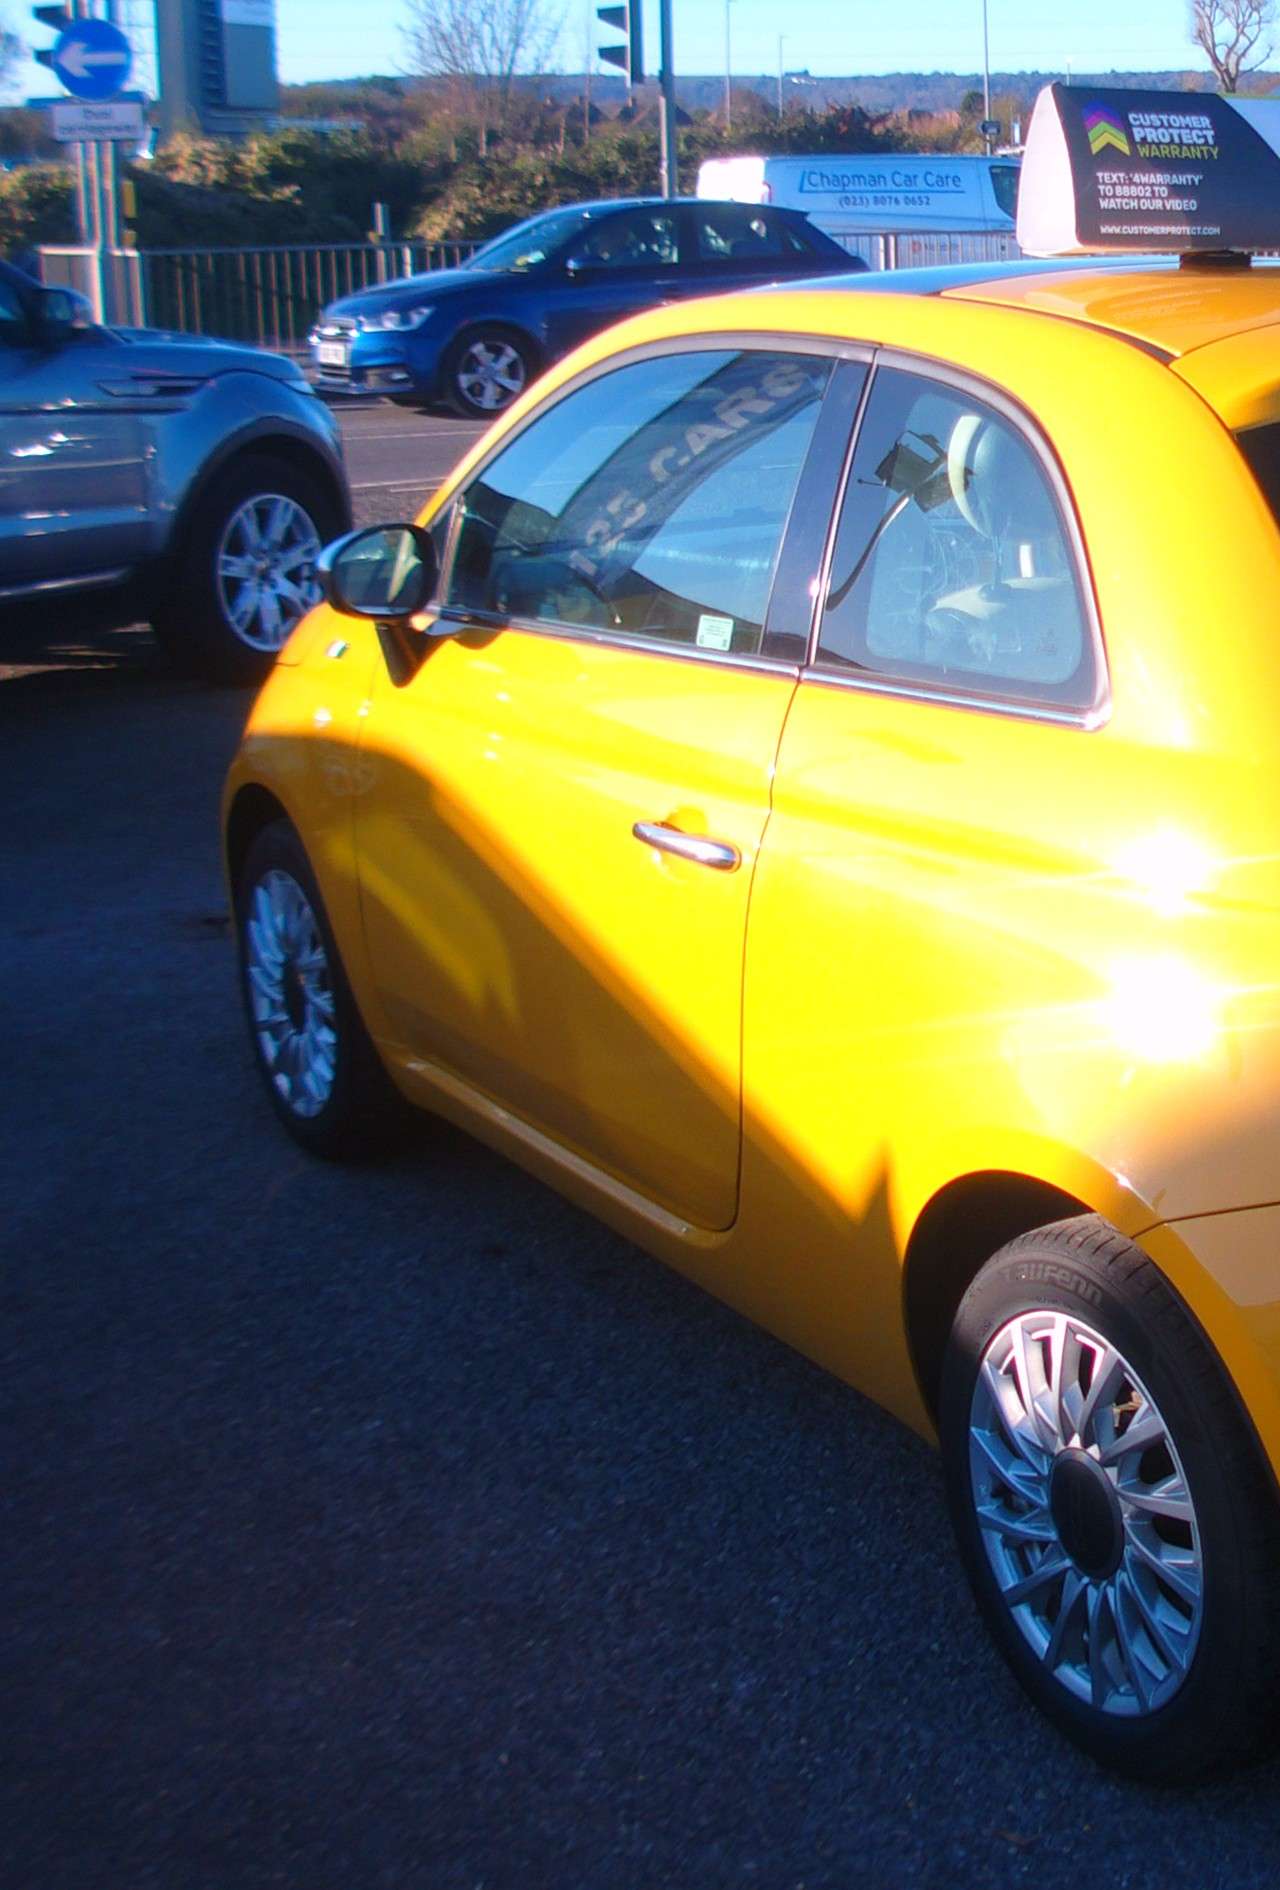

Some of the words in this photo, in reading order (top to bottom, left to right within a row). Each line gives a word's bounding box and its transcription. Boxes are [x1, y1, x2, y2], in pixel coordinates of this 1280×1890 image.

[1128, 113, 1212, 129] CUSTOMER
[1132, 128, 1215, 145] PROTECT
[1137, 144, 1219, 160] WARRANTY
[807, 170, 888, 191] Chapman
[891, 170, 918, 188] Car
[923, 171, 961, 188] Care
[1096, 172, 1128, 185] TEXT:
[1098, 185, 1113, 196] TO
[1153, 187, 1168, 197] TO
[839, 196, 870, 208] (023)
[1099, 199, 1138, 210] WATCH
[1140, 200, 1163, 211] OUR
[1165, 200, 1197, 211] VIDEO
[1100, 226, 1221, 236] WWW.CUSTOMERPROTECT.COM
[648, 363, 811, 483] CARS
